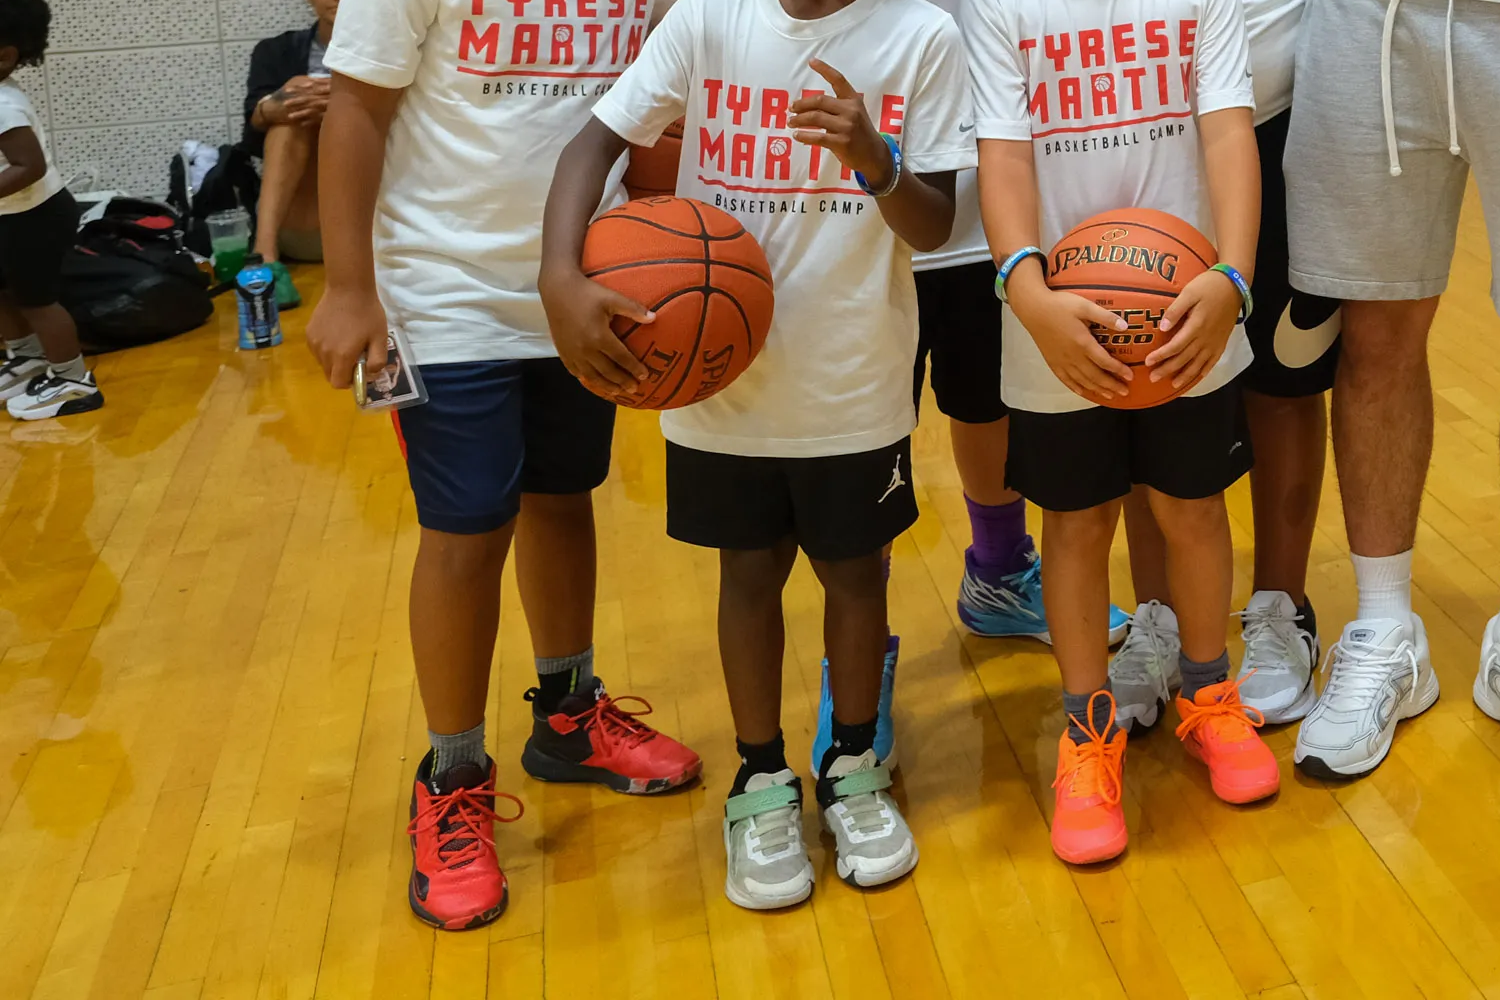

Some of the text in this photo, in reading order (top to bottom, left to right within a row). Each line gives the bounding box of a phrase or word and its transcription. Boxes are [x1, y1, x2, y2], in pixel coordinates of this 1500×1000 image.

[457, 19, 644, 65] MARTIN
[1018, 19, 1198, 74] TYRESE
[482, 82, 588, 97] BASKETBALL
[703, 78, 905, 135] TYRE
[1045, 124, 1186, 156] BASKETBALL CAMP
[715, 193, 864, 215] BASKETBALL CAMP
[1050, 244, 1180, 283] SPALDING
